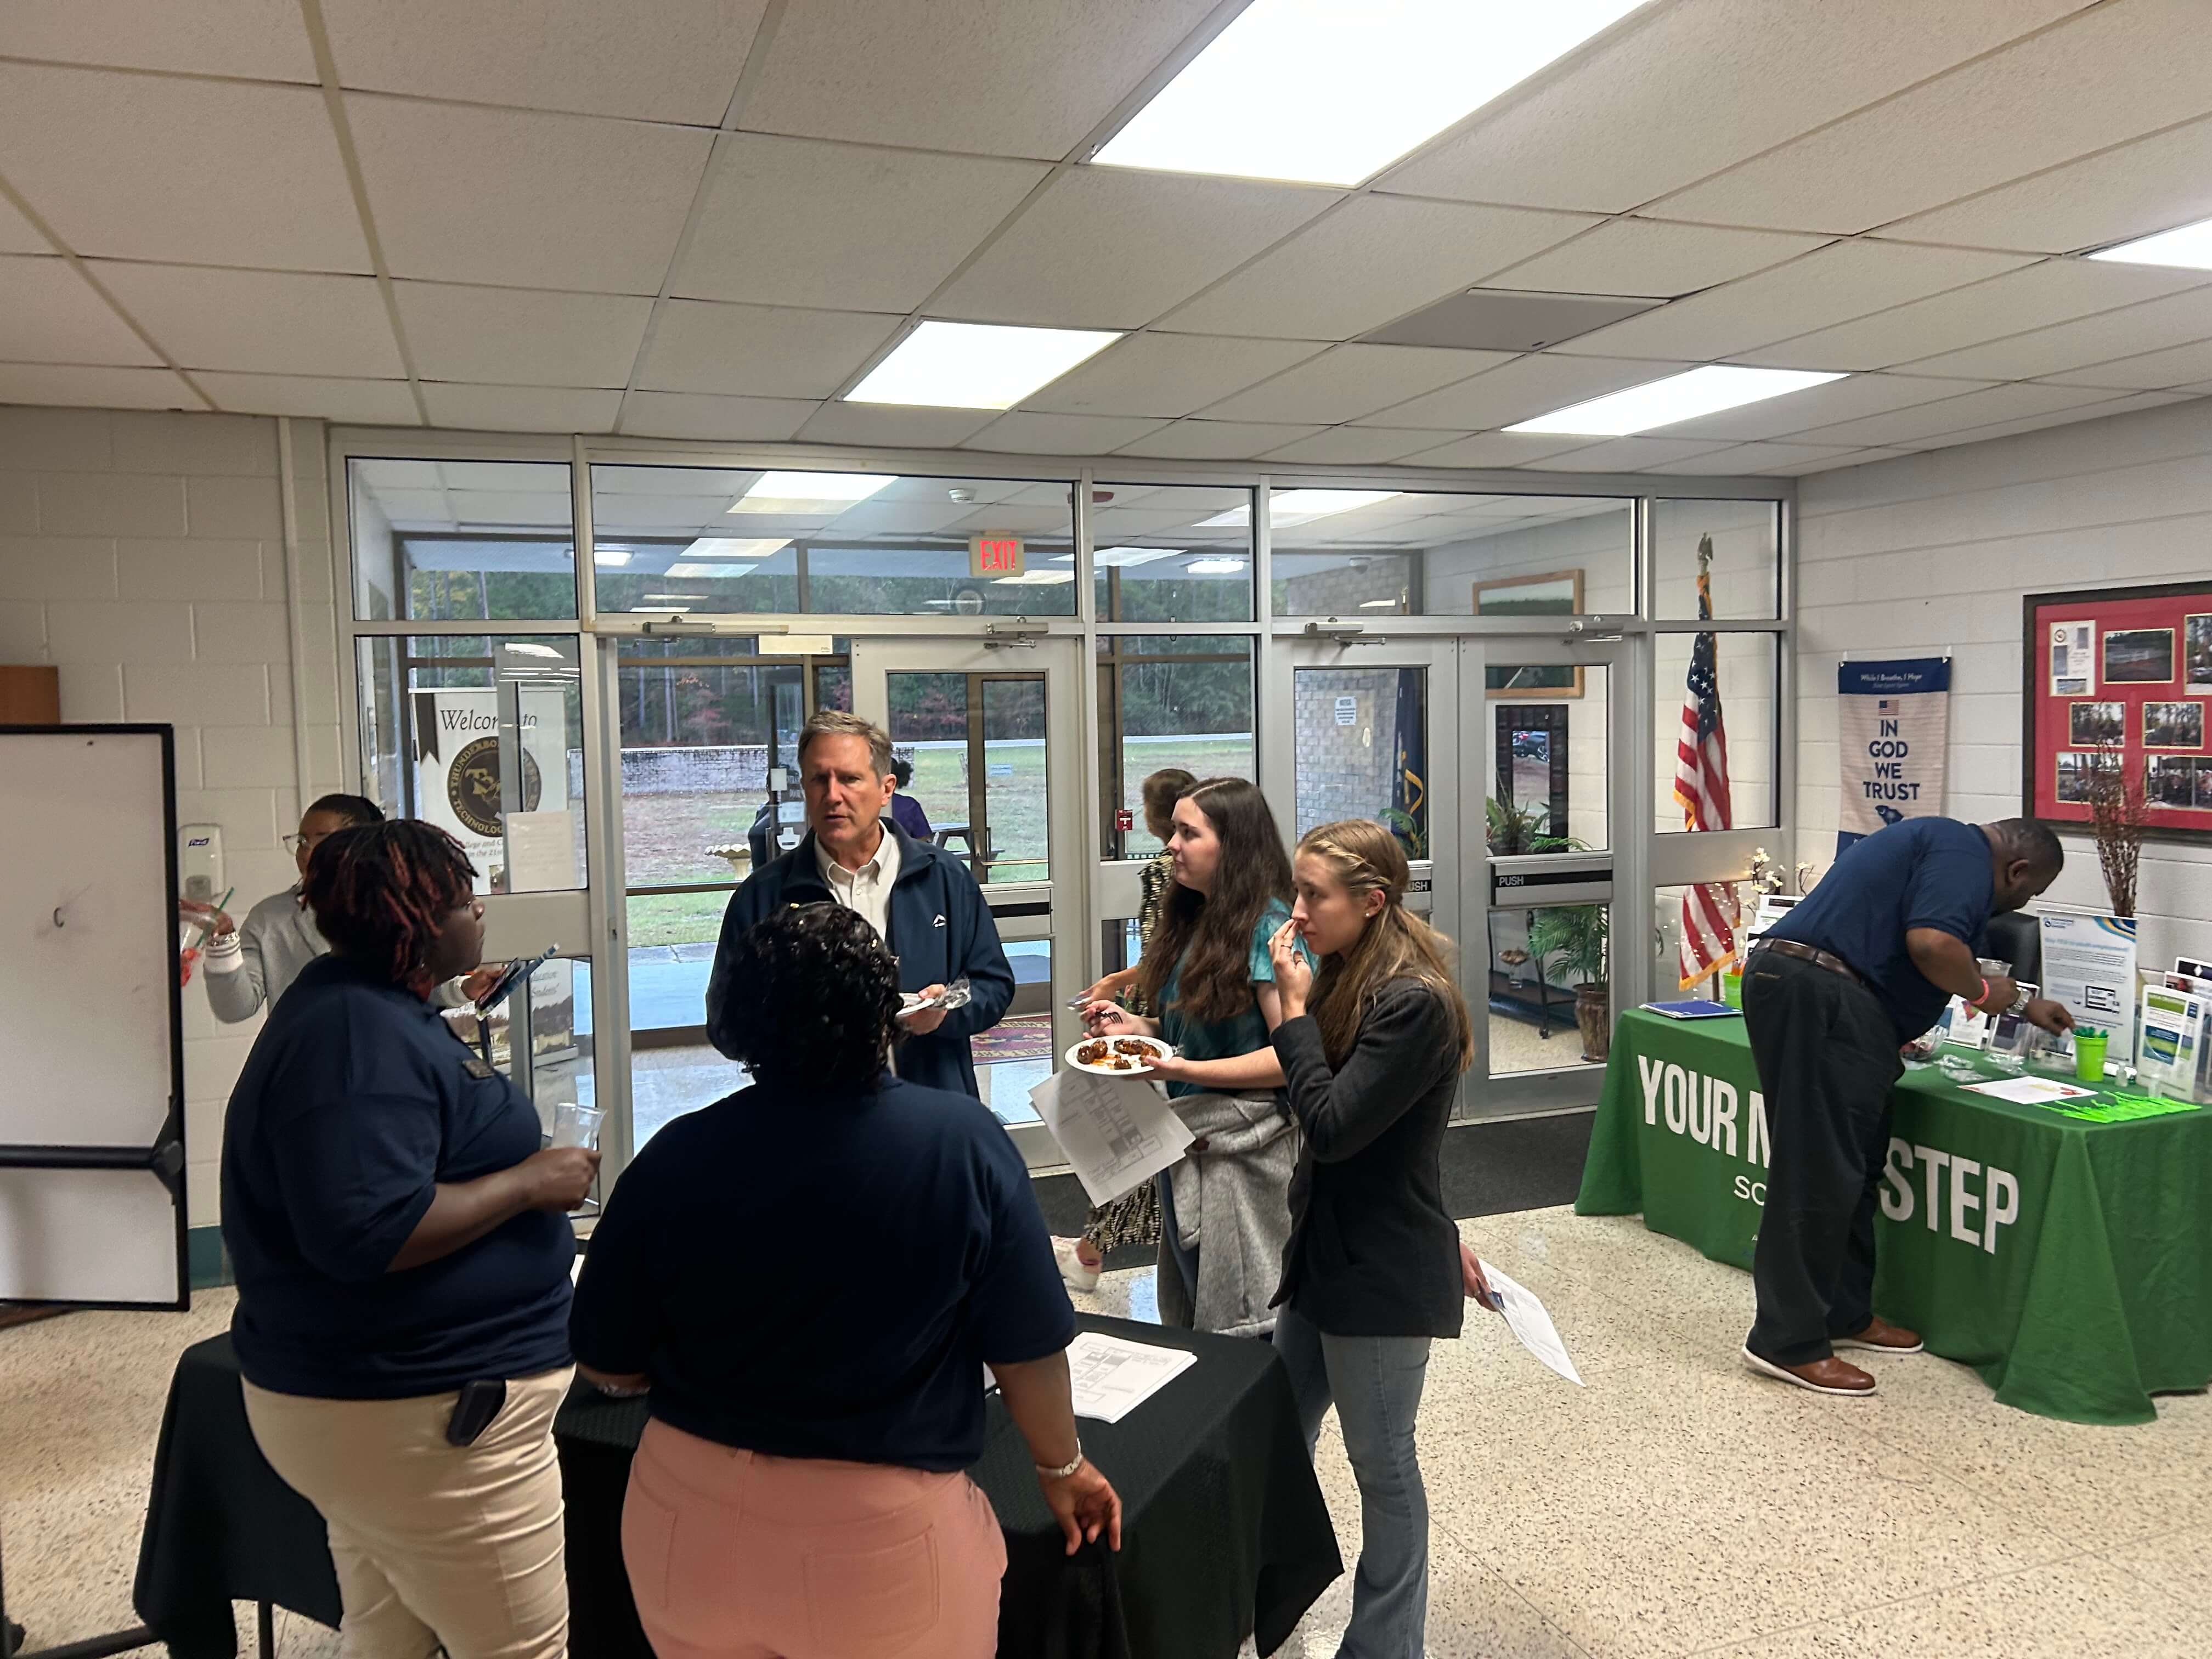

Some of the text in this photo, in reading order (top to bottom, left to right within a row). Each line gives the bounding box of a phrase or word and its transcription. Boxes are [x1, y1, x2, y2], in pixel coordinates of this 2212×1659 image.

[979, 539, 1018, 571] EXIT
[522, 714, 537, 727] to
[1880, 720, 1898, 737] IN
[1869, 741, 1908, 758] GOD
[1875, 762, 1902, 779] WE
[1863, 781, 1920, 800] TRUST
[1407, 881, 1427, 891] USH
[1499, 876, 1523, 886] PUSH
[1638, 1054, 1739, 1157] YOUR
[1880, 1137, 2019, 1255] STEP
